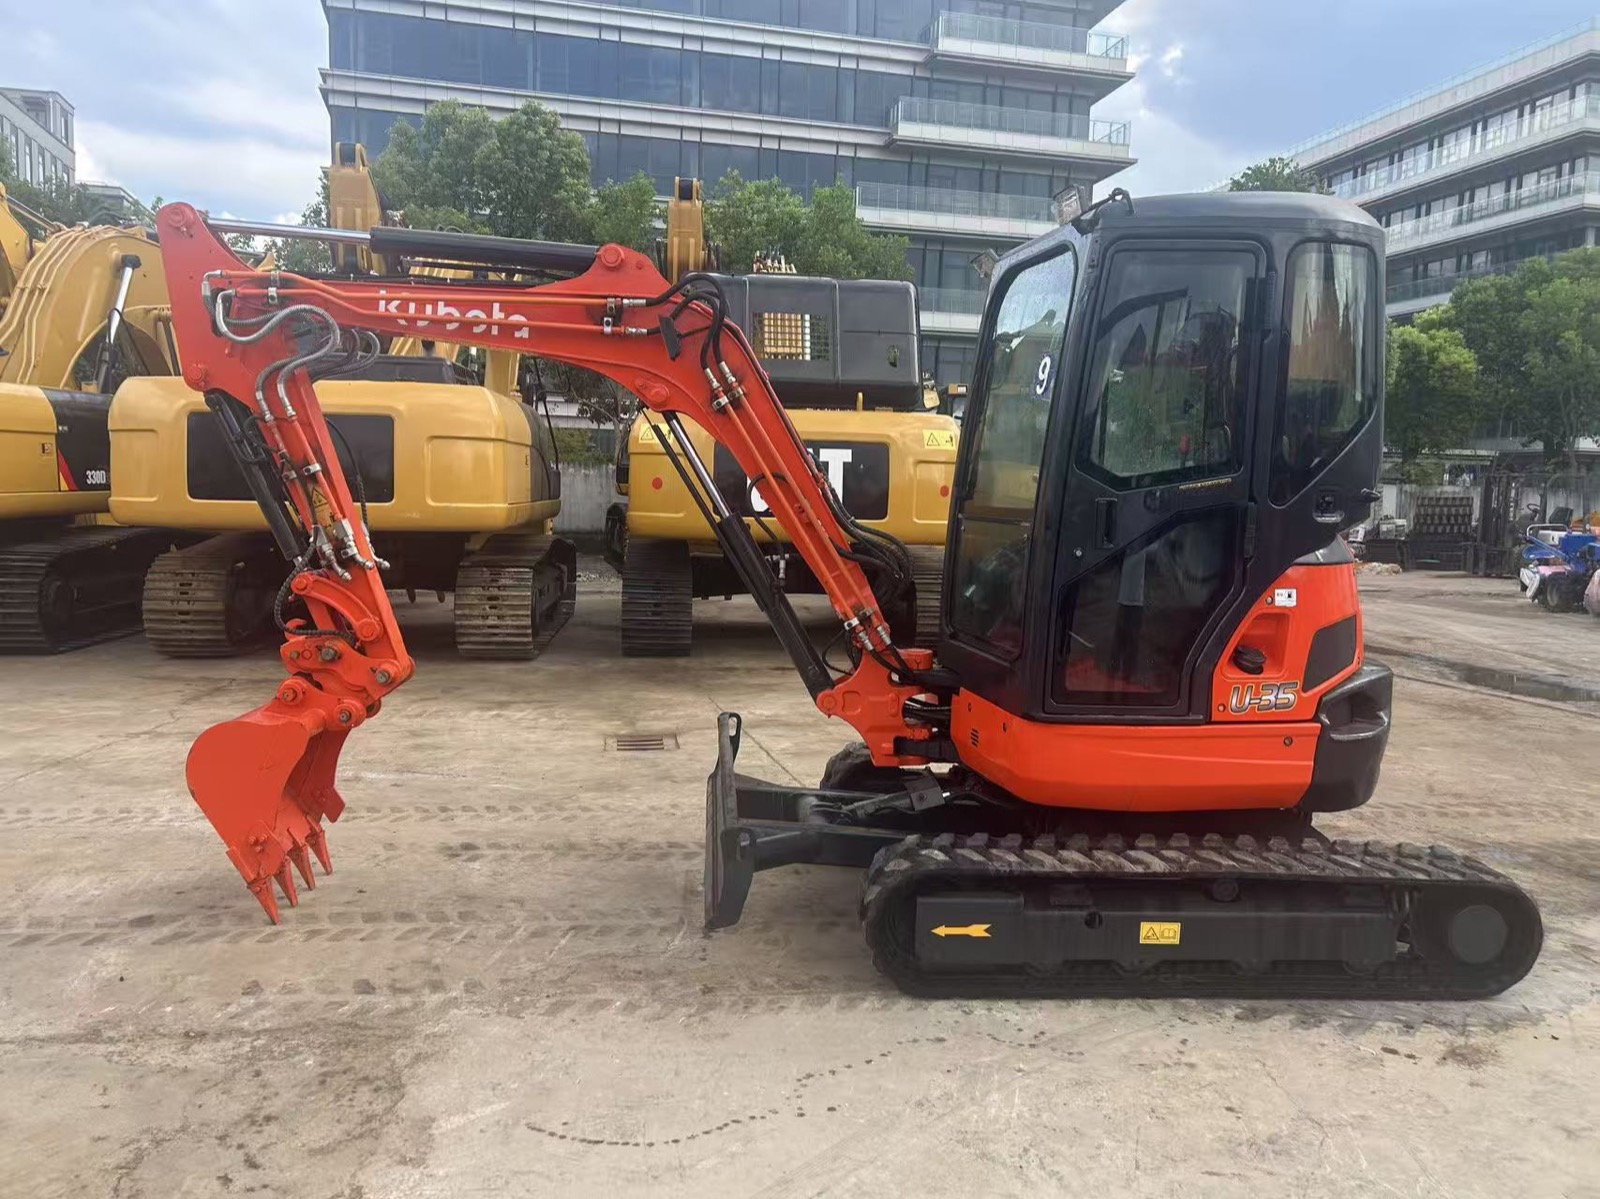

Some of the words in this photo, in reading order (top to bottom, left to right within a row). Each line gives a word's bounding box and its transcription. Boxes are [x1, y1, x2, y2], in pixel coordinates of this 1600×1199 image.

[1036, 356, 1051, 395] 9
[86, 470, 106, 485] 330D
[1229, 680, 1299, 715] U-35
